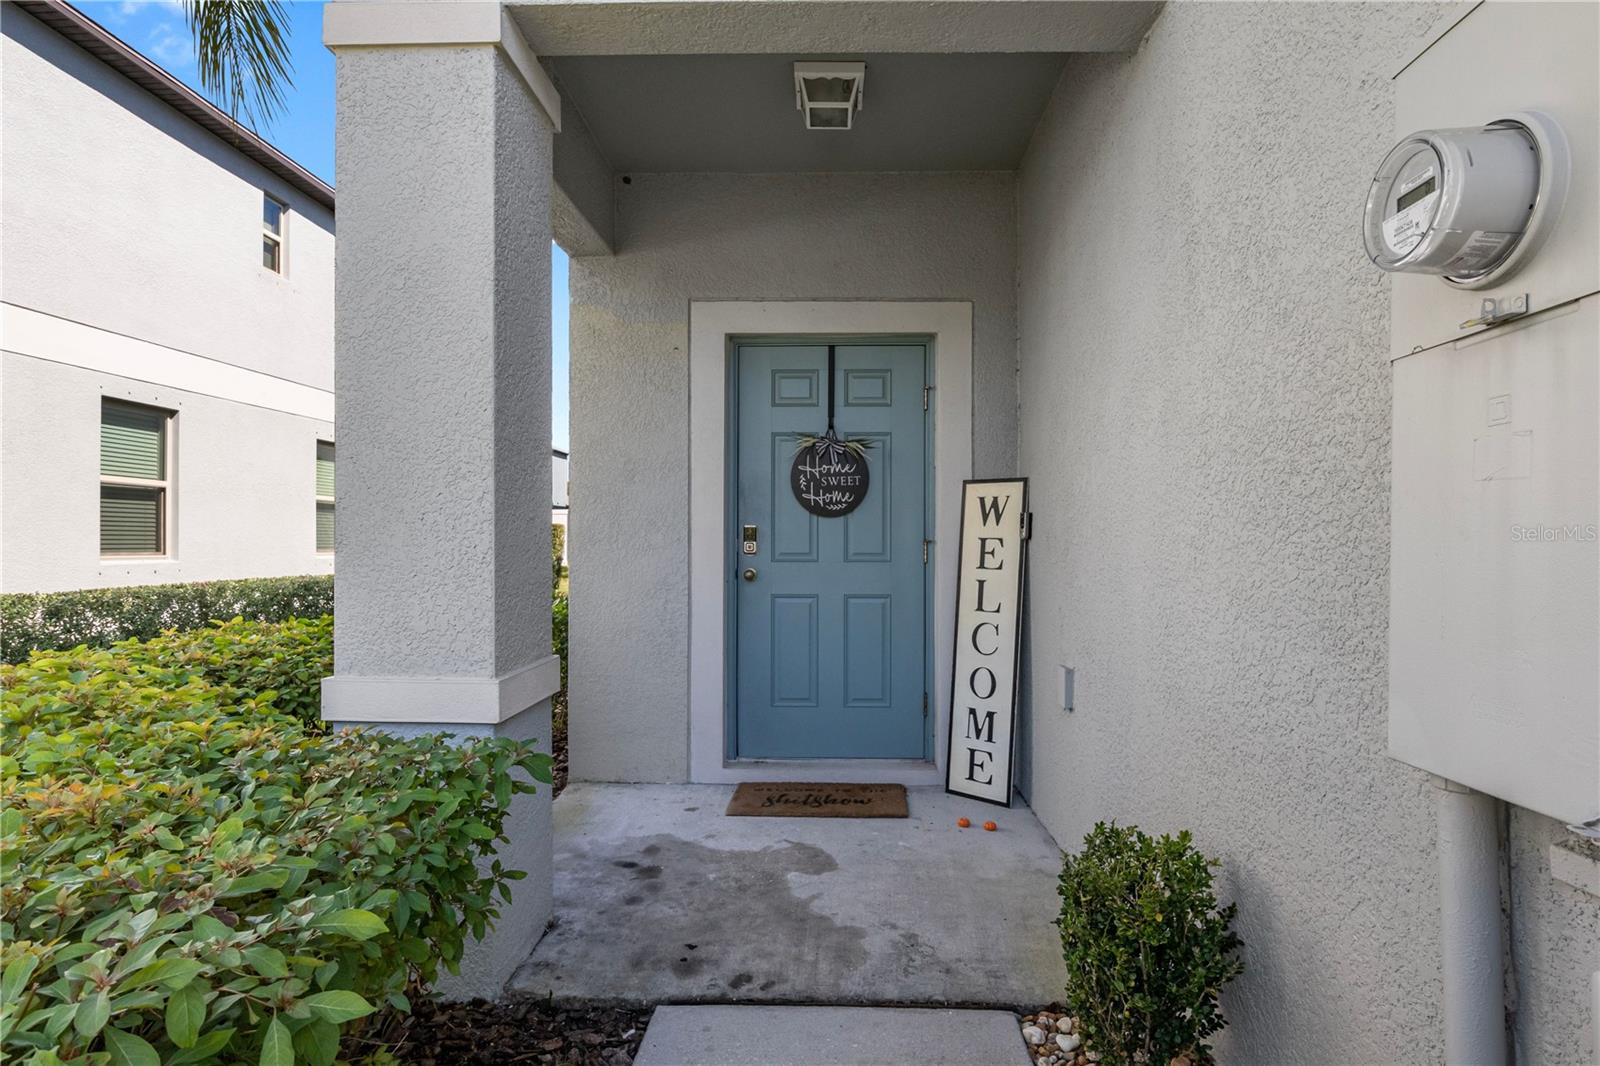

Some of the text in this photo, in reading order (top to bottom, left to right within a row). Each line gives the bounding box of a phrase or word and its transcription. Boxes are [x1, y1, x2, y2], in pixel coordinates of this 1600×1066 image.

[798, 455, 856, 479] Home
[821, 475, 861, 486] SWEET
[802, 482, 855, 506] Home
[965, 495, 1010, 785] WELCOME
